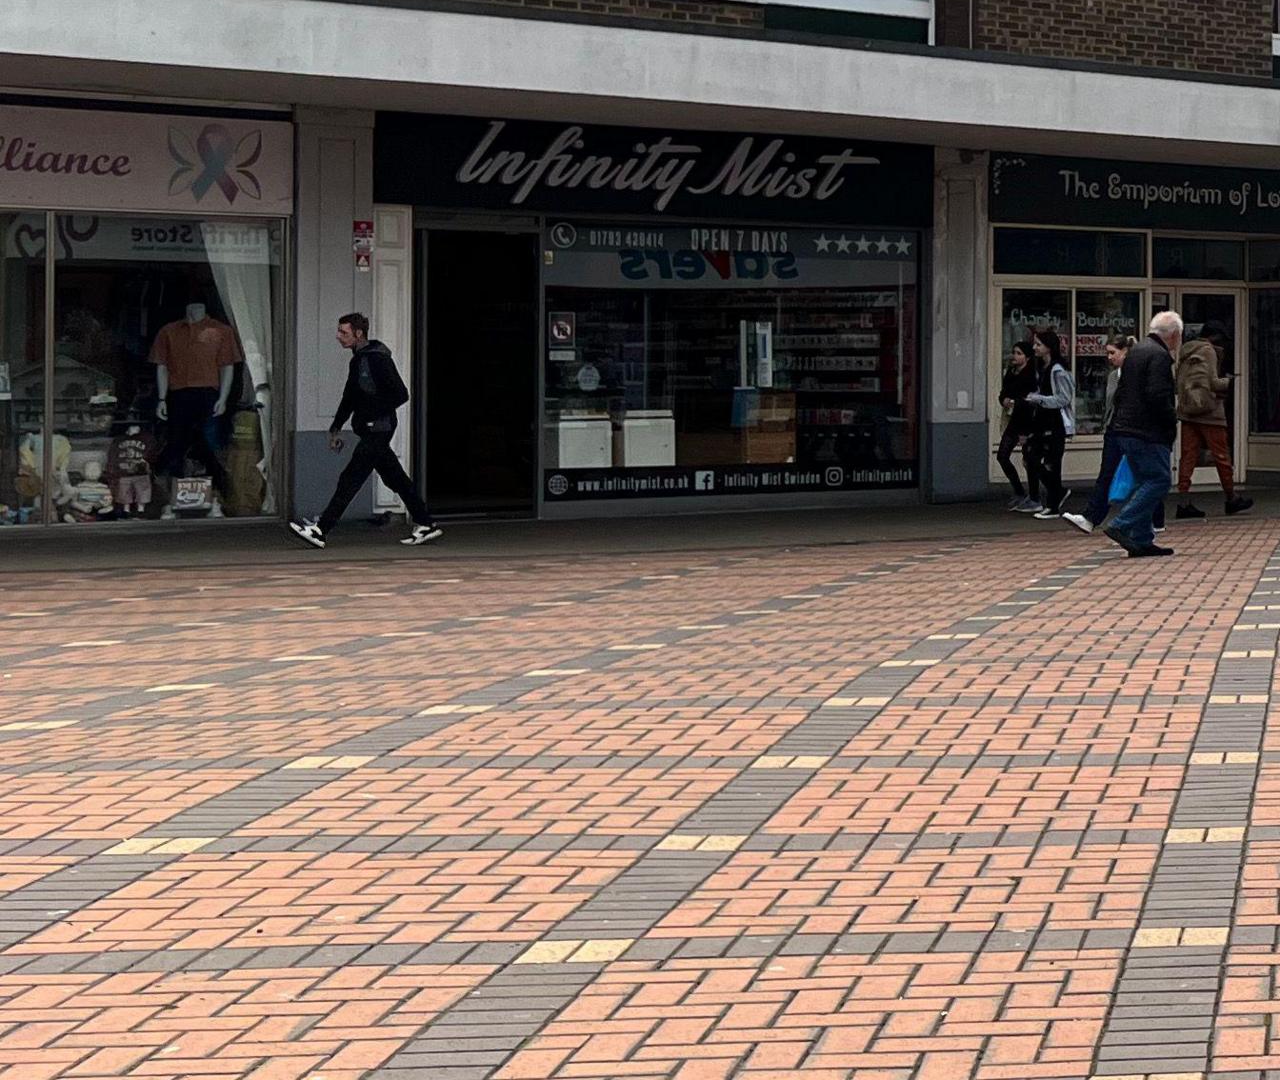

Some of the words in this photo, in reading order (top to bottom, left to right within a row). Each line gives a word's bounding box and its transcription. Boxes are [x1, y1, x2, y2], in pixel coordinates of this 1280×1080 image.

[0, 135, 131, 176] liance
[456, 120, 702, 212] Infinity
[688, 136, 881, 201] Mist
[1058, 170, 1101, 199] The
[1107, 173, 1222, 209] Emporium
[1229, 182, 1252, 215] of
[690, 228, 730, 252] OPEN
[737, 230, 745, 252] 7
[752, 230, 788, 253] DAYS
[1010, 308, 1061, 331] Charity
[1076, 309, 1136, 332] Boutique
